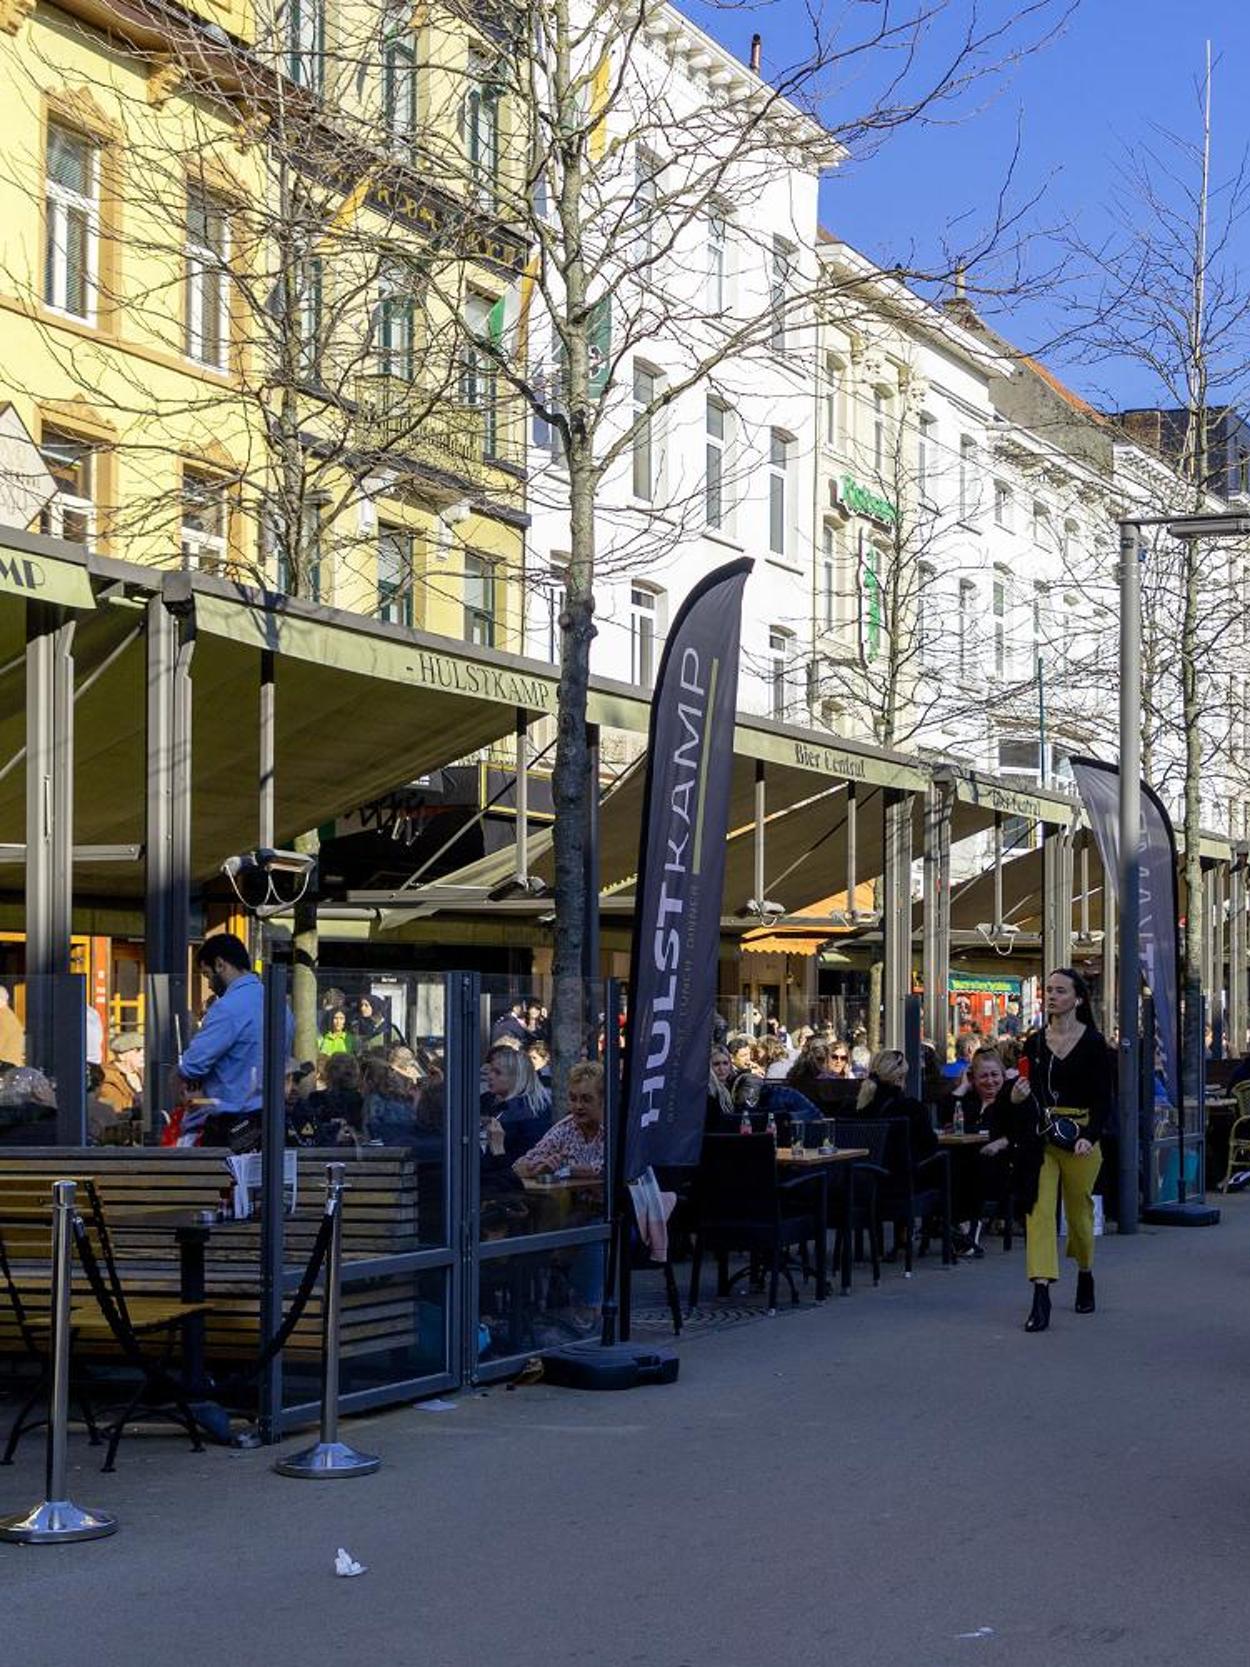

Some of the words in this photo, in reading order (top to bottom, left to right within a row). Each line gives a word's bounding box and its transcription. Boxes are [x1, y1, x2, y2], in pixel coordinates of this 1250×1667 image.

[419, 653, 549, 709] HULSTKAMP
[795, 743, 820, 768] Bier
[824, 750, 866, 778] Central
[641, 647, 705, 1128] HULSTKAMP
